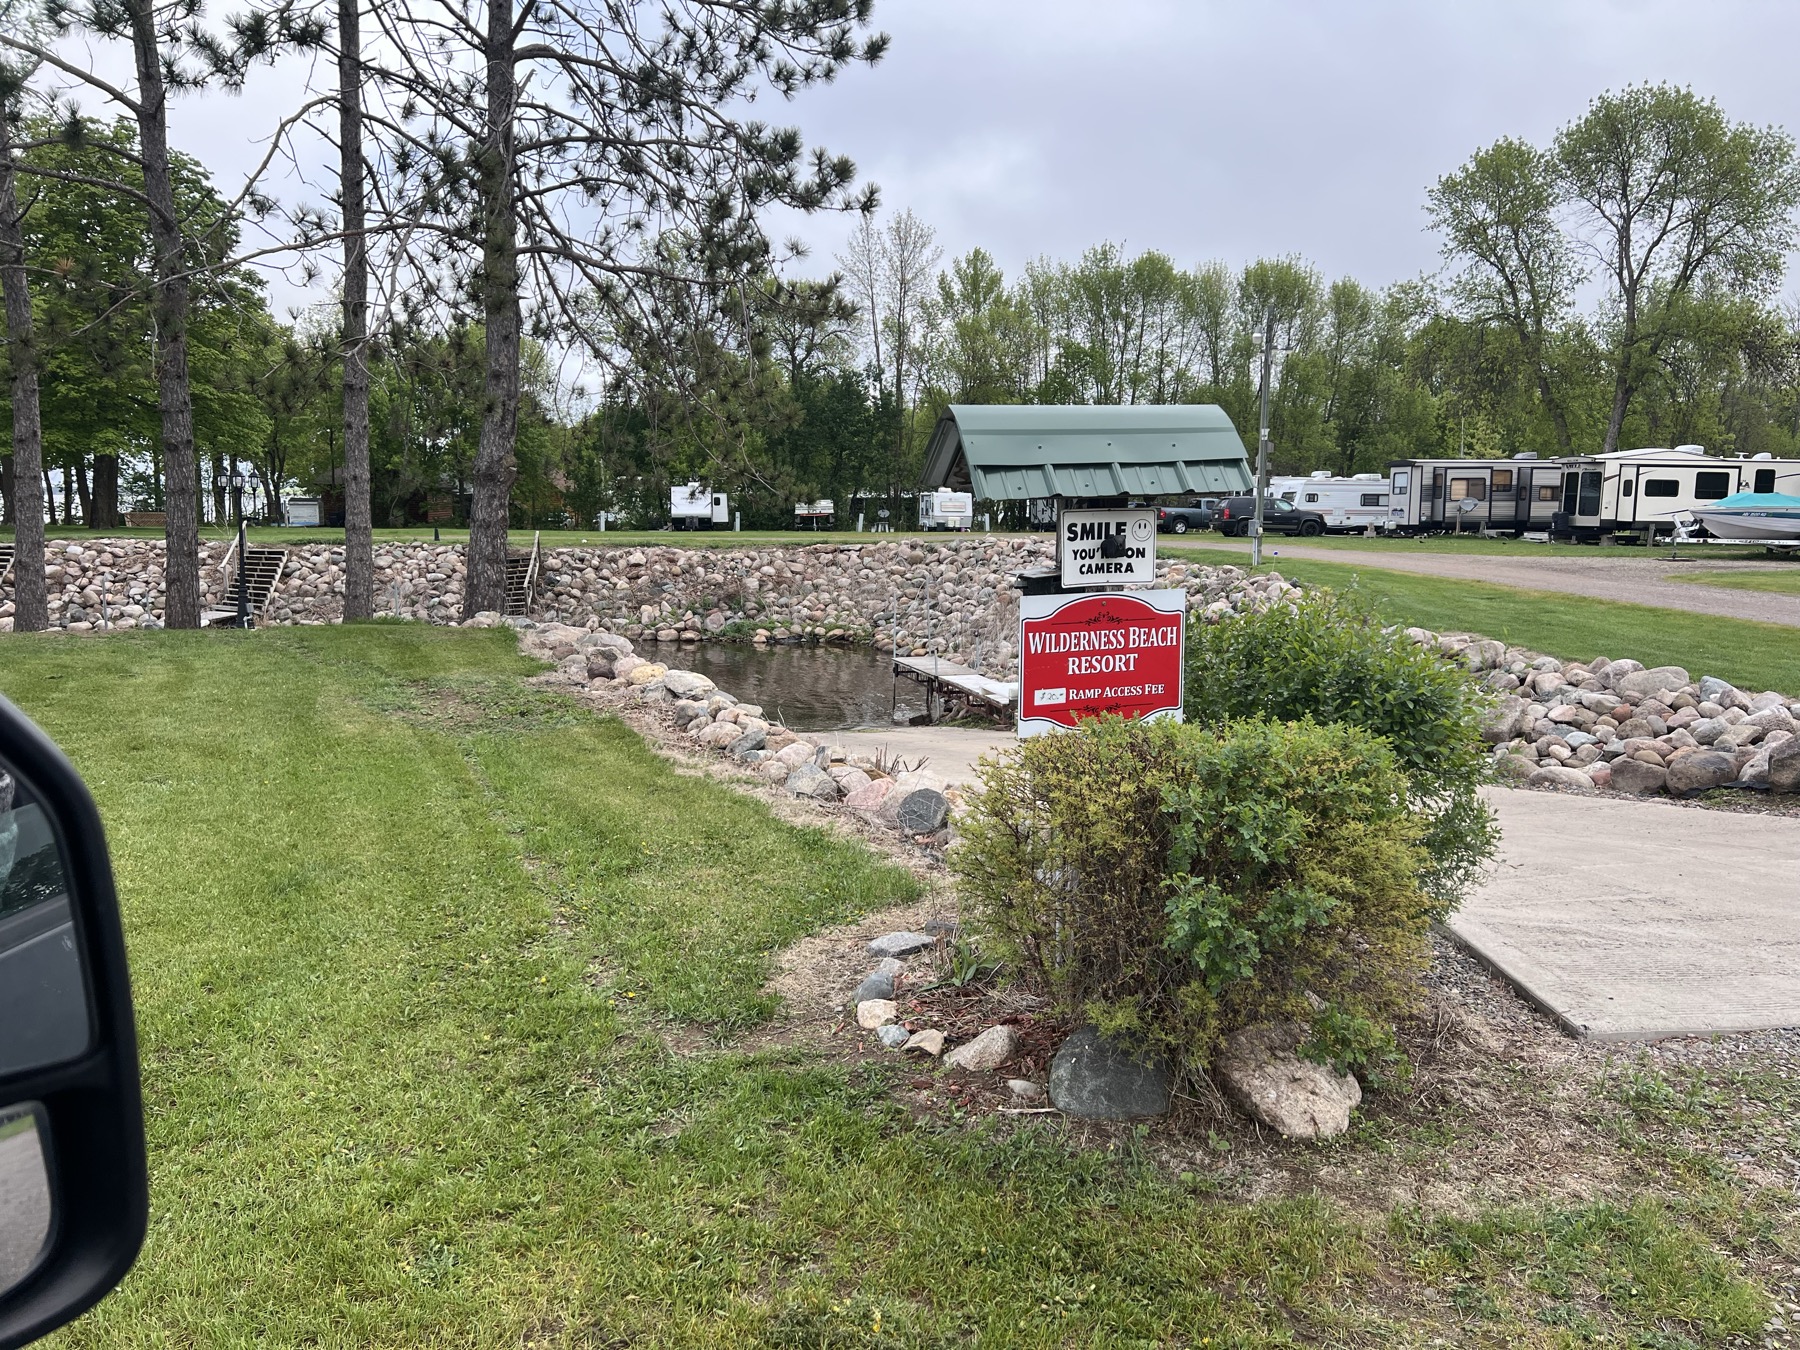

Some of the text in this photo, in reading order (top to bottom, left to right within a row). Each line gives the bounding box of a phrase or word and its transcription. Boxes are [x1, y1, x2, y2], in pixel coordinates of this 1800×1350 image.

[1067, 522, 1127, 542] SMILE
[1072, 547, 1146, 560] YOU' ON
[1079, 562, 1134, 575] CAMERA
[1028, 626, 1178, 654] WILDERNESS BEACH
[1067, 654, 1138, 675] RESORT
[1069, 684, 1165, 700] RAMP ACCESS FEE
